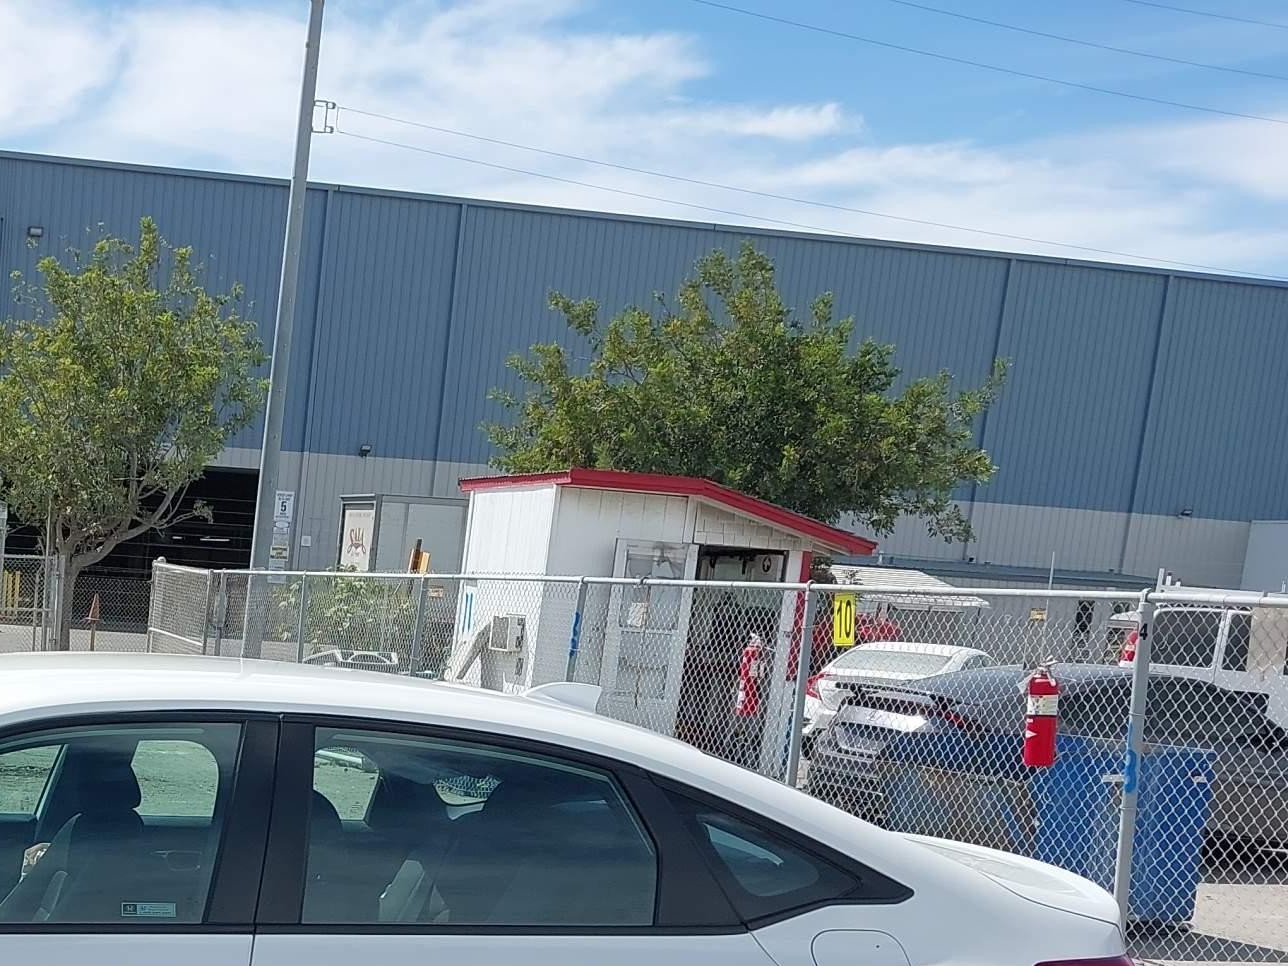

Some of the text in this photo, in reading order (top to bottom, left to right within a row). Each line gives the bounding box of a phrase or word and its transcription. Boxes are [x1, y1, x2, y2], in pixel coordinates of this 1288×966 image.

[280, 501, 287, 512] 5
[837, 600, 852, 638] 10
[1139, 623, 1148, 641] 4
